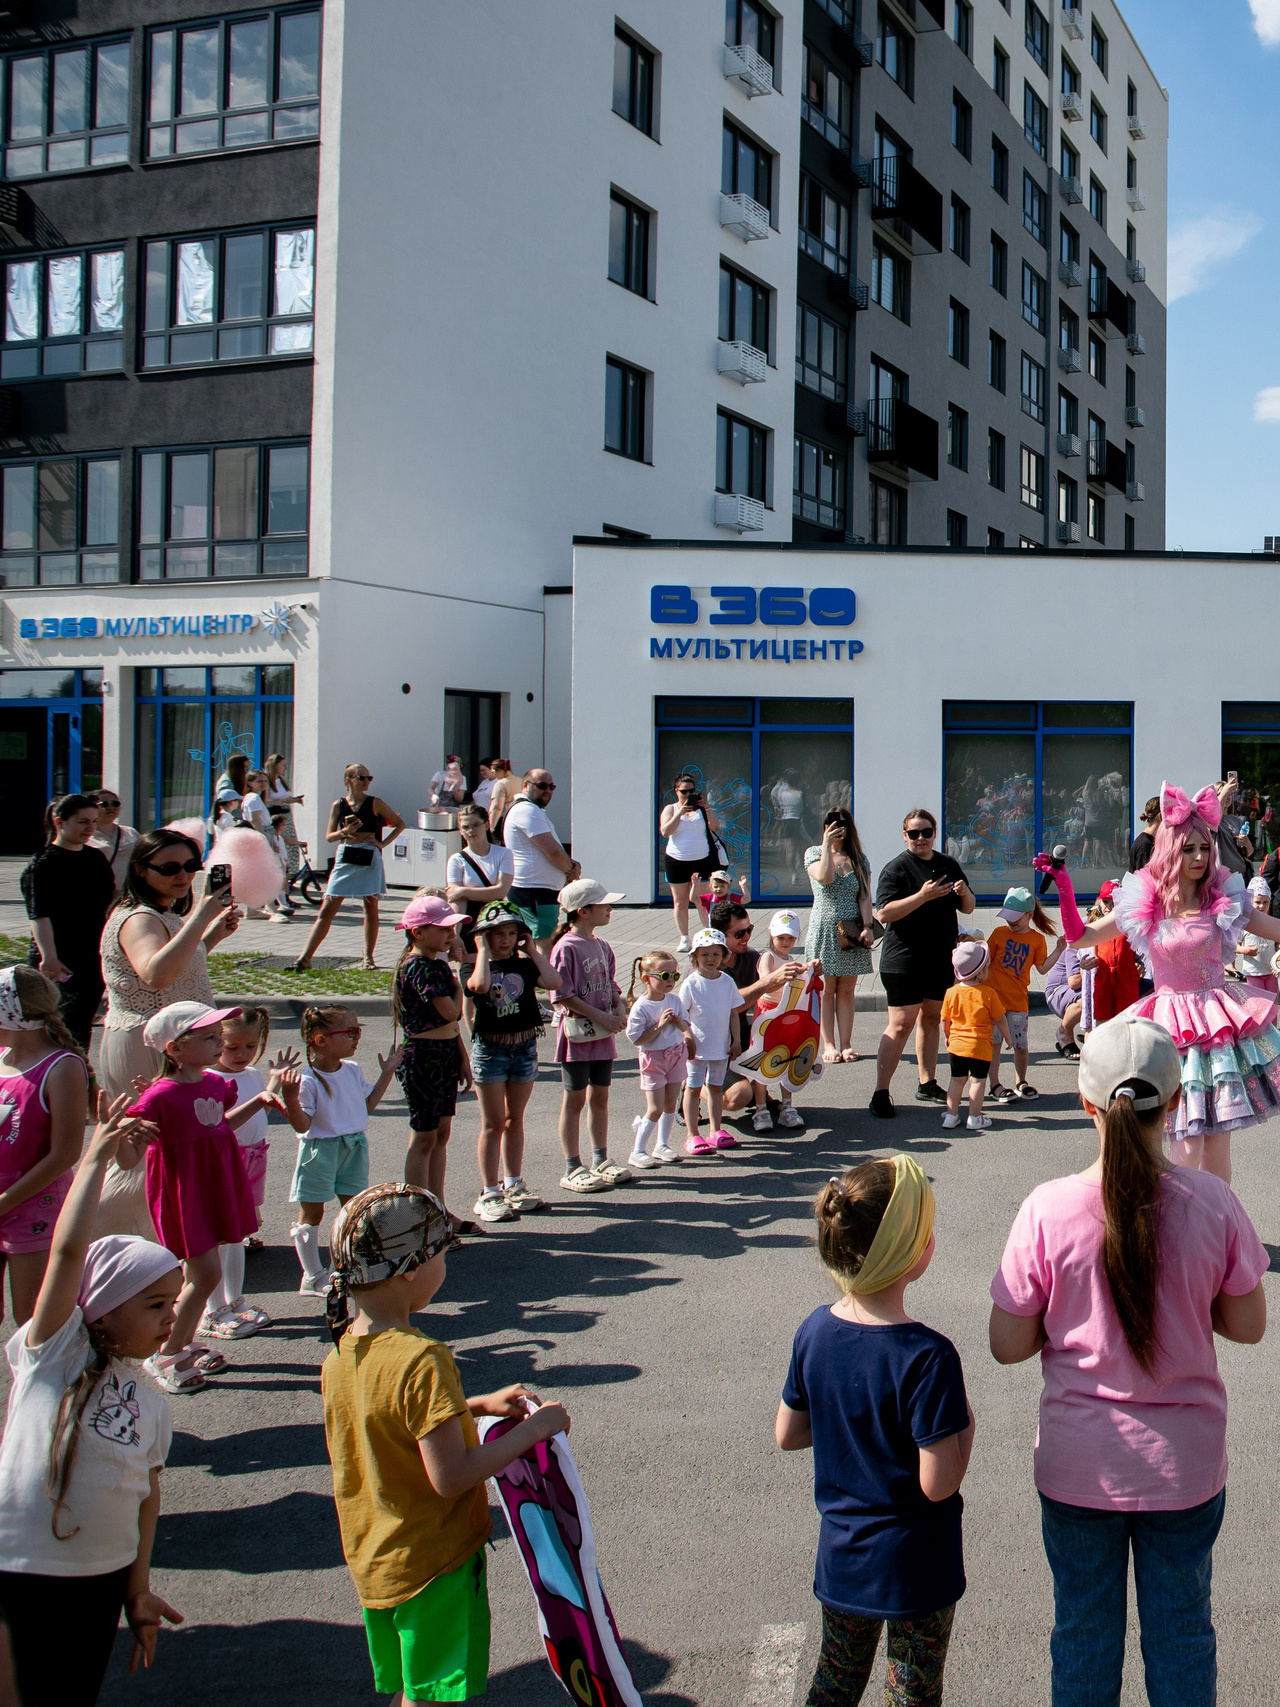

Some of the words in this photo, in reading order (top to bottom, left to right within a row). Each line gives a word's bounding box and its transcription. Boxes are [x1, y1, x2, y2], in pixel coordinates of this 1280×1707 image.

[709, 586, 856, 626] 360
[106, 614, 255, 638] МУЛЬТИЦЕНТР
[650, 637, 865, 664] МУЛЬТИЦЕНТР
[1004, 938, 1030, 957] SUN
[1002, 951, 1027, 977] DAY
[496, 1003, 520, 1018] LOVE
[5, 1097, 21, 1145] PARADISE
